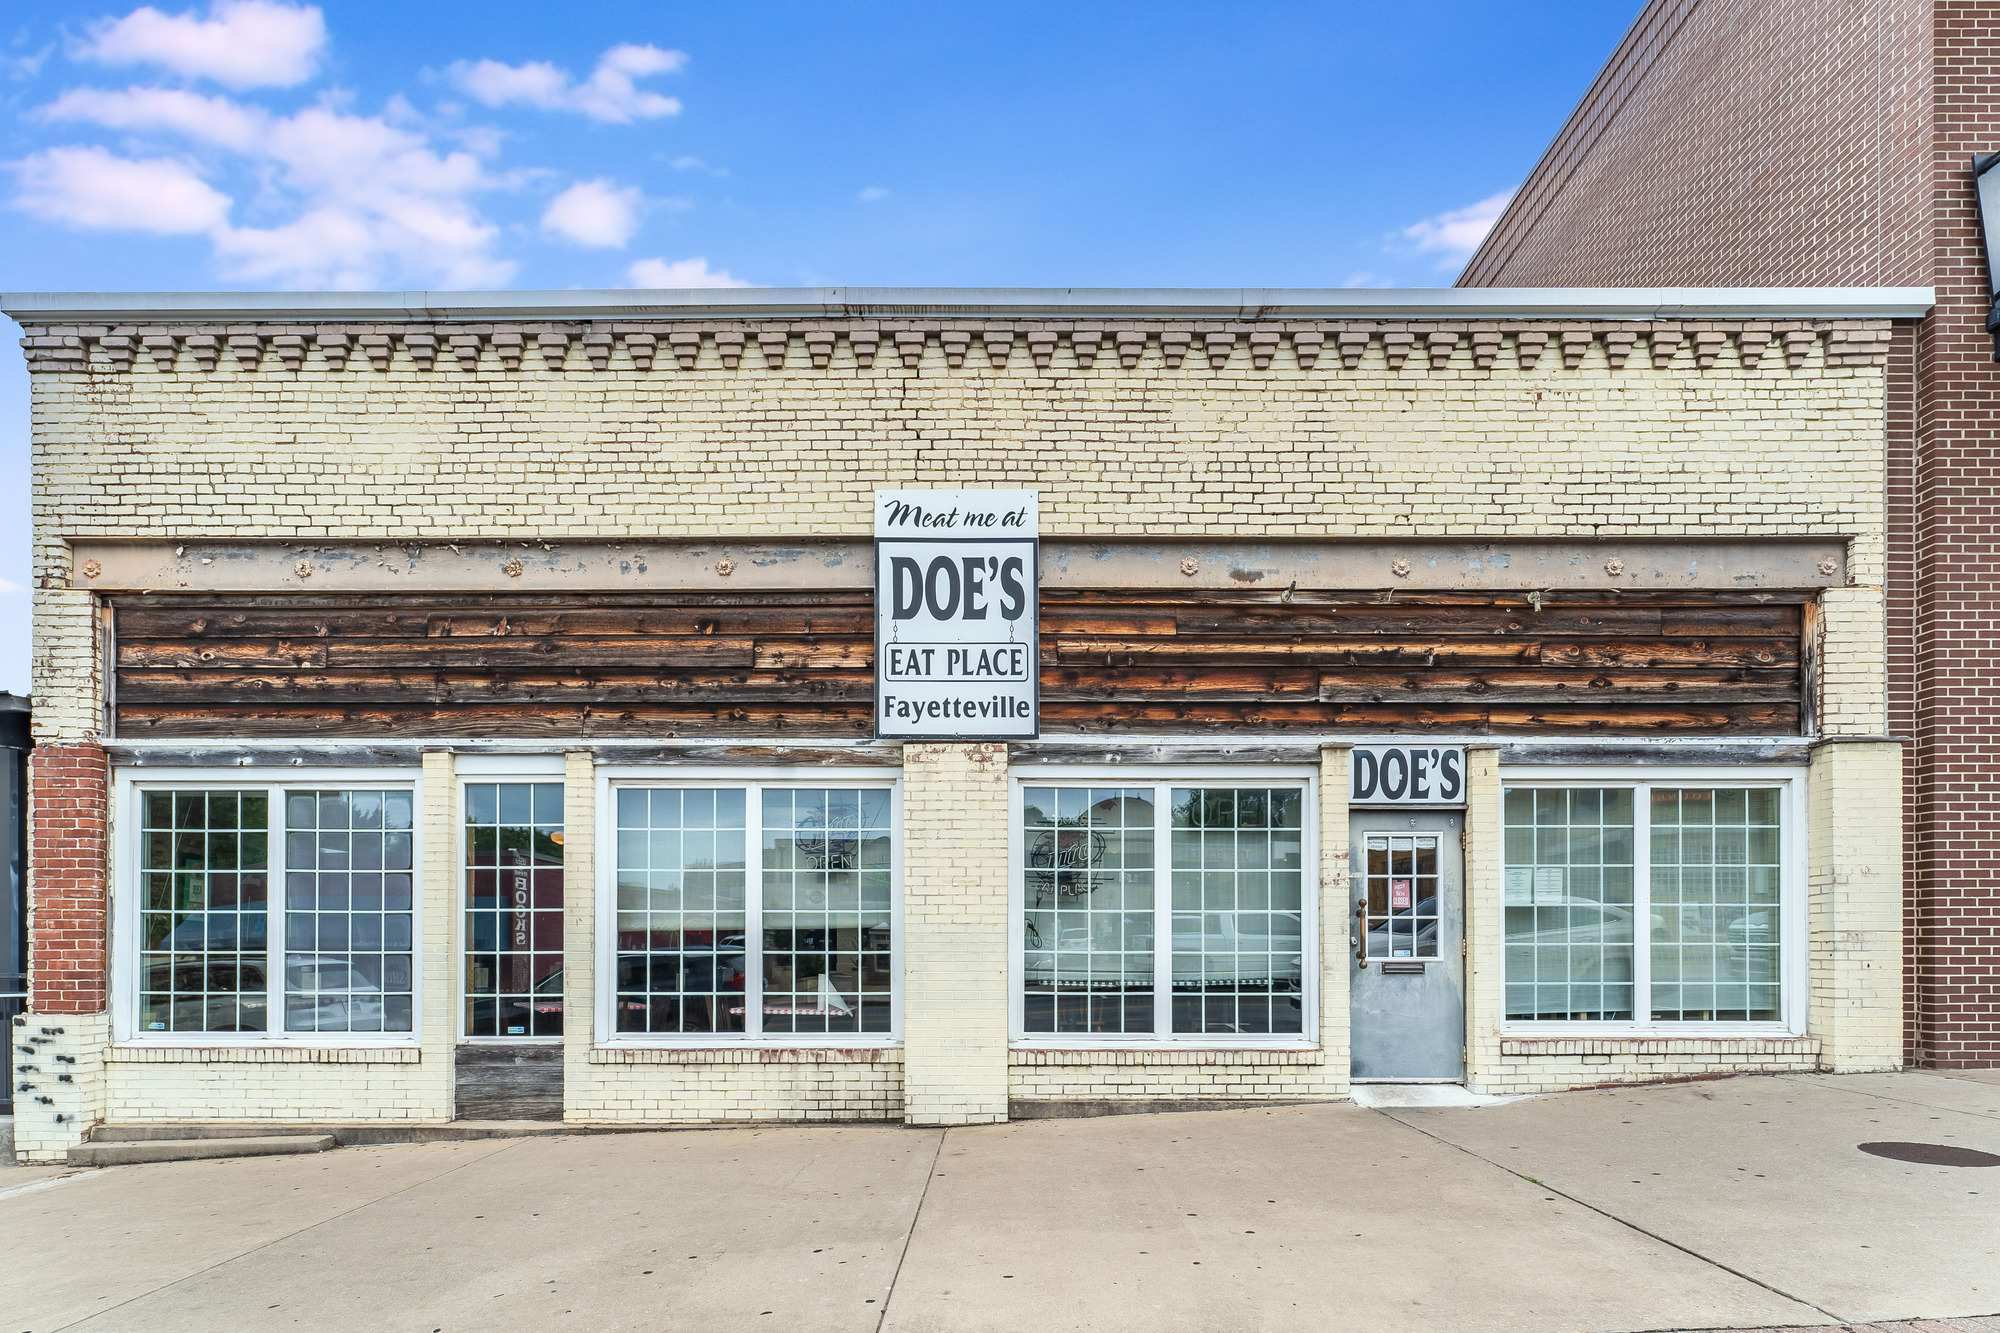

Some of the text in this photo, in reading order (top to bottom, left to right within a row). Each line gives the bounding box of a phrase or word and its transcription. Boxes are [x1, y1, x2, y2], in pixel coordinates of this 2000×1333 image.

[884, 500, 1028, 528] Meat me at
[890, 555, 1025, 621] DOE'S
[890, 648, 1023, 676] EAT PLACE
[884, 695, 1030, 724] Fayetteville
[1352, 748, 1461, 800] DOE'S
